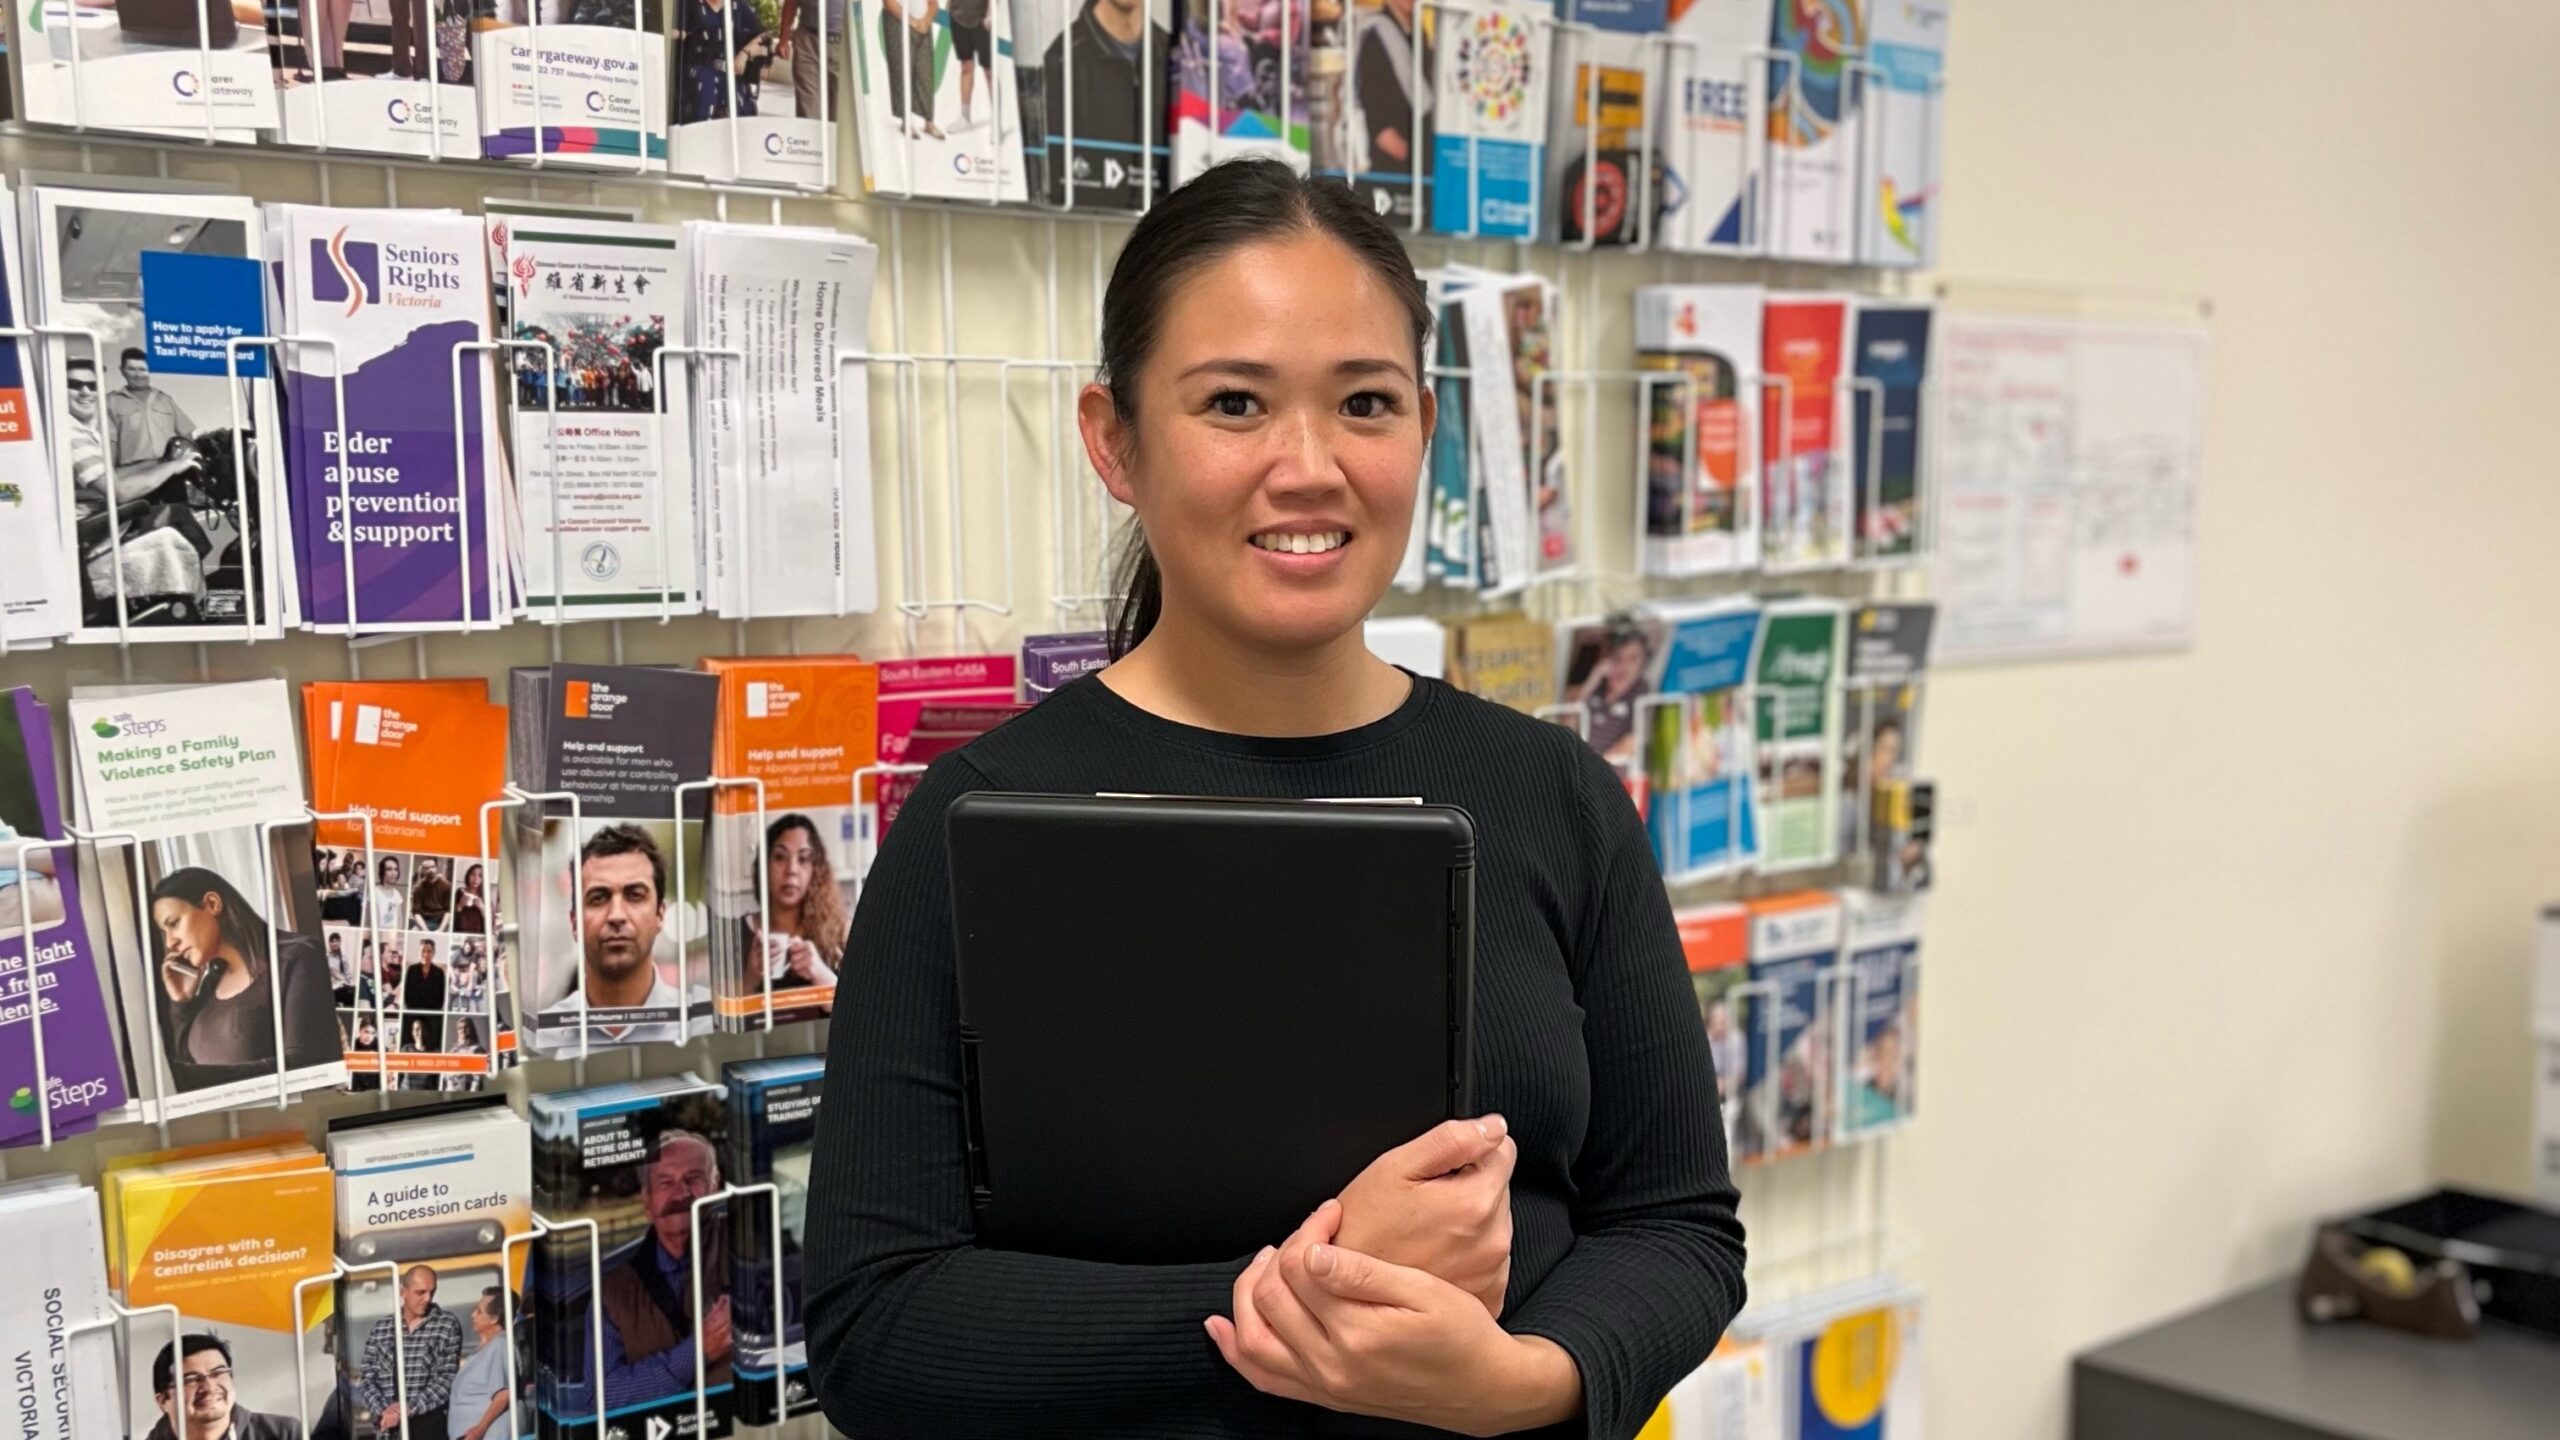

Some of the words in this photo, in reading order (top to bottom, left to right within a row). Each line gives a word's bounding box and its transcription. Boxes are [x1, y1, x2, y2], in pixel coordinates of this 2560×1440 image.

[511, 46, 639, 71] carrgateway.gov.a
[206, 74, 234, 85] arer
[207, 85, 254, 98] ateway
[609, 94, 632, 105] Carer
[609, 104, 640, 115] Gatewa
[787, 136, 810, 147] Carer
[385, 243, 460, 266] Seniors
[388, 266, 460, 293] Rights
[791, 280, 800, 298] Who
[387, 292, 442, 309] Victoria
[814, 281, 827, 318] Home
[153, 321, 178, 332] How
[181, 323, 193, 333] to
[195, 325, 225, 337] apply
[227, 326, 242, 336] for
[164, 334, 191, 346] Multi
[194, 336, 229, 350] Purpo
[154, 346, 177, 357] Taxi
[179, 347, 226, 361] Program
[230, 350, 255, 361] ard
[813, 321, 825, 382] Delivered
[815, 386, 826, 423] Meals
[584, 428, 611, 437] Office
[613, 428, 641, 437] Hours
[323, 431, 393, 454] Eder
[327, 520, 345, 542] &
[354, 522, 455, 548] support
[880, 667, 910, 682] South
[912, 665, 952, 679] Eastern
[954, 663, 987, 676] CASA
[1051, 661, 1079, 674] South
[591, 682, 610, 693] the
[769, 683, 784, 691] the
[590, 693, 628, 705] orange
[769, 692, 800, 701] orange
[383, 708, 400, 720] the
[590, 701, 615, 712] door
[769, 701, 791, 710] door
[113, 712, 132, 722] safe
[381, 719, 418, 732] orange
[123, 717, 167, 738] steps
[380, 728, 405, 740] door
[98, 745, 162, 764] Making
[167, 744, 177, 754] a
[182, 735, 239, 753] Family
[563, 741, 585, 752] Help
[586, 743, 605, 752] and
[607, 744, 644, 754] support
[748, 749, 774, 761] Help
[776, 747, 797, 759] and
[800, 746, 844, 759] support
[100, 762, 175, 782] Violence
[180, 754, 234, 772] Safety
[239, 748, 276, 763] Plan
[563, 755, 571, 764] is
[572, 755, 615, 766] available
[616, 757, 630, 766] for
[631, 758, 652, 766] men
[653, 758, 673, 768] who
[561, 768, 579, 777] use
[579, 767, 616, 778] abusive
[617, 770, 628, 778] or
[629, 770, 679, 782] controlling
[560, 779, 608, 790] behaviour
[609, 782, 619, 791] at
[621, 782, 648, 792] home
[649, 784, 660, 792] or
[661, 784, 669, 792] in
[348, 804, 378, 819] Help
[380, 808, 406, 821] and
[409, 809, 461, 826] support
[346, 820, 362, 832] for
[374, 823, 426, 838] ictorians
[32, 940, 75, 962] ight
[46, 1076, 63, 1091] afe
[50, 1077, 108, 1109] steps
[768, 1097, 810, 1113] STUDYING
[768, 1107, 813, 1124] TRAINING?
[583, 1131, 615, 1146] ABOUT
[617, 1129, 630, 1140] TO
[365, 1151, 415, 1164] INFORMATION
[416, 1149, 430, 1158] FOR
[431, 1143, 473, 1155] CUSTOMERS
[583, 1143, 616, 1157] RETIRE
[617, 1140, 631, 1151] OR
[632, 1138, 643, 1149] IN
[583, 1148, 647, 1169] RETIREMENT?
[367, 1191, 379, 1207] A
[384, 1186, 429, 1207] guide
[432, 1183, 449, 1197] to
[368, 1200, 460, 1226] concession
[464, 1192, 508, 1211] cards
[154, 1244, 225, 1263] Disagree
[228, 1239, 261, 1253] with
[264, 1238, 275, 1248] a
[237, 1247, 308, 1267] decision?
[43, 1287, 64, 1358] SOCIAL
[14, 1350, 39, 1440] VICTORIA
[677, 1409, 714, 1424] Serves
